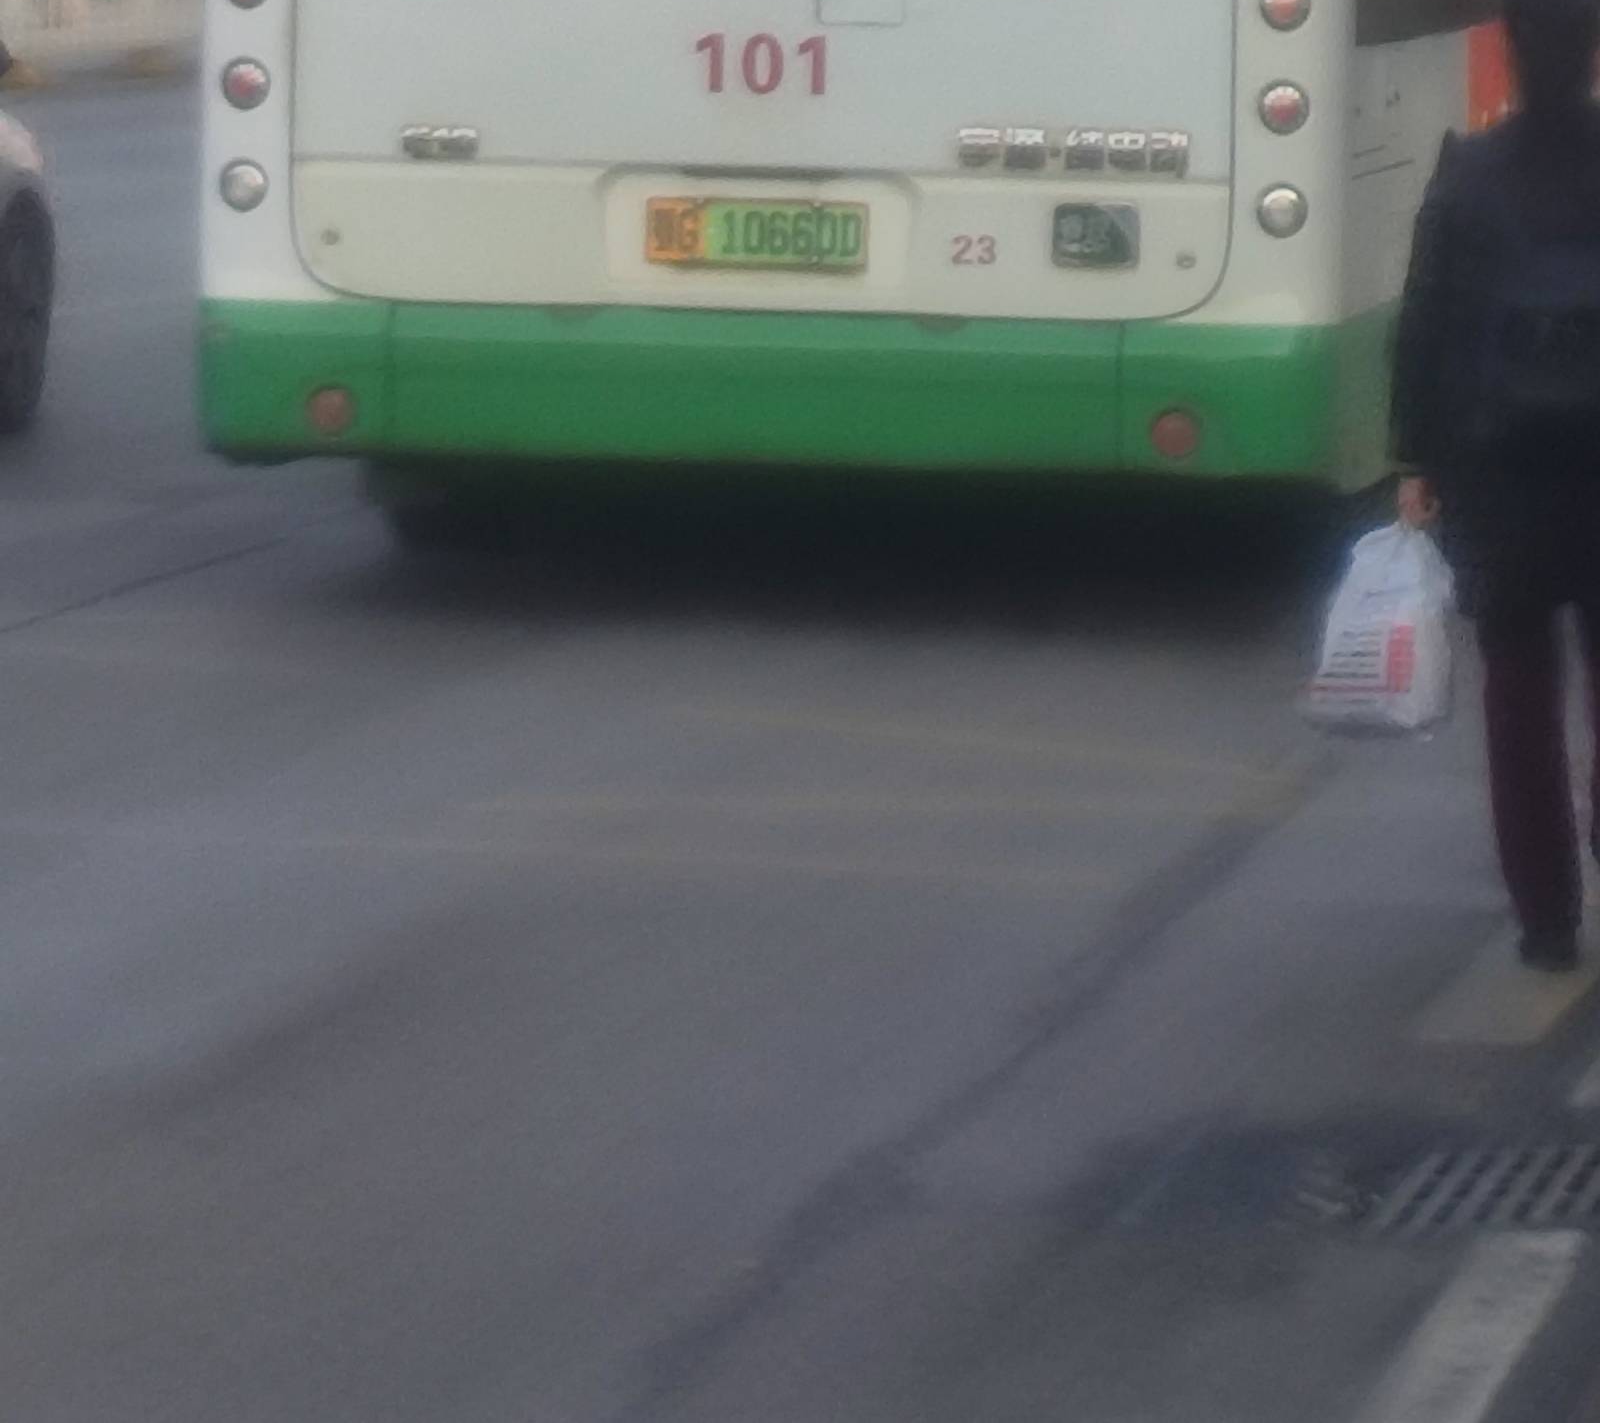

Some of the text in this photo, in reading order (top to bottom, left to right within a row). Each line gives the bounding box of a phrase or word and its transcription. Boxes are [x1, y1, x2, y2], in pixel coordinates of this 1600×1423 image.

[695, 33, 827, 95] 101
[721, 207, 862, 258] 10660D
[951, 234, 997, 265] 23
